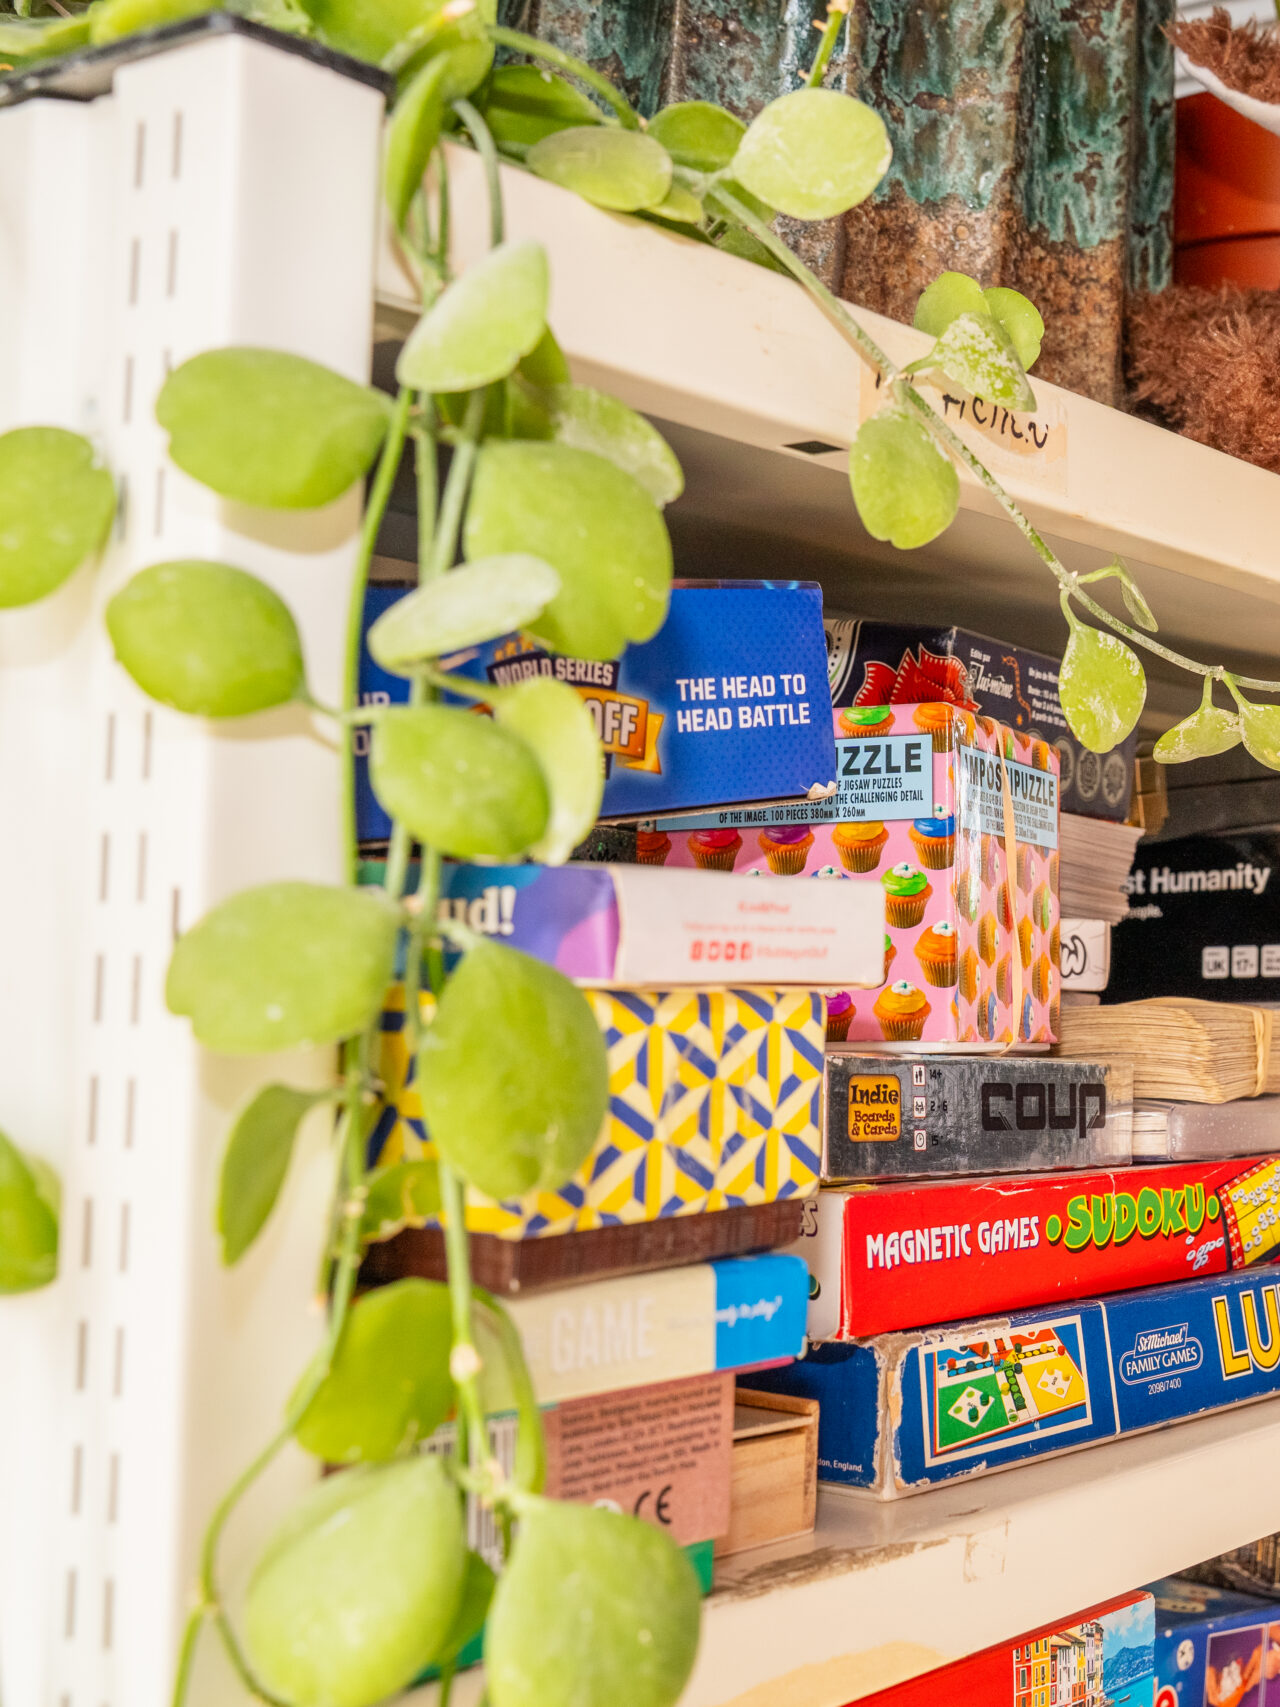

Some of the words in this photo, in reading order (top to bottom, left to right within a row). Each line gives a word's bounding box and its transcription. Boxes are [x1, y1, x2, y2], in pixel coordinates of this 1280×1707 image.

[493, 658, 552, 688] WORLD
[555, 657, 614, 687] SERIES
[675, 677, 717, 702] THE
[722, 675, 776, 699] HEAD
[779, 673, 807, 696] TO
[676, 706, 733, 733] HEAD
[737, 702, 811, 729] BATTLE
[835, 742, 922, 776] ZZLE
[835, 780, 842, 792] F
[843, 777, 871, 791] JIGSAW
[872, 776, 903, 790] PUZZLES
[963, 752, 1055, 808] IMPOSIPUZZLE
[835, 793, 848, 805] THE
[850, 789, 898, 805] CHALLENGING
[900, 789, 924, 802] DETAIL
[719, 812, 728, 824] OF
[730, 811, 742, 823] THE
[744, 810, 769, 823] IMAGE.
[771, 809, 783, 821] 100
[785, 808, 808, 820] PIECES
[1150, 861, 1271, 896] Humanity
[929, 1068, 942, 1080] 14+
[850, 1084, 899, 1106] Indie
[930, 1100, 936, 1112] 2
[942, 1100, 948, 1112] 6
[854, 1110, 895, 1123] Boards
[851, 1122, 861, 1136] &
[863, 1122, 898, 1136] Cards
[866, 1224, 972, 1271] MAGNETIC
[977, 1215, 1040, 1258] GAMES
[1062, 1182, 1206, 1251] SUDOKU
[552, 1297, 656, 1375] GAME
[1126, 1354, 1161, 1377] FAMILY
[1162, 1346, 1198, 1368] GAMES
[1147, 1377, 1182, 1396] 2098/7400
[833, 1459, 864, 1473] England.
